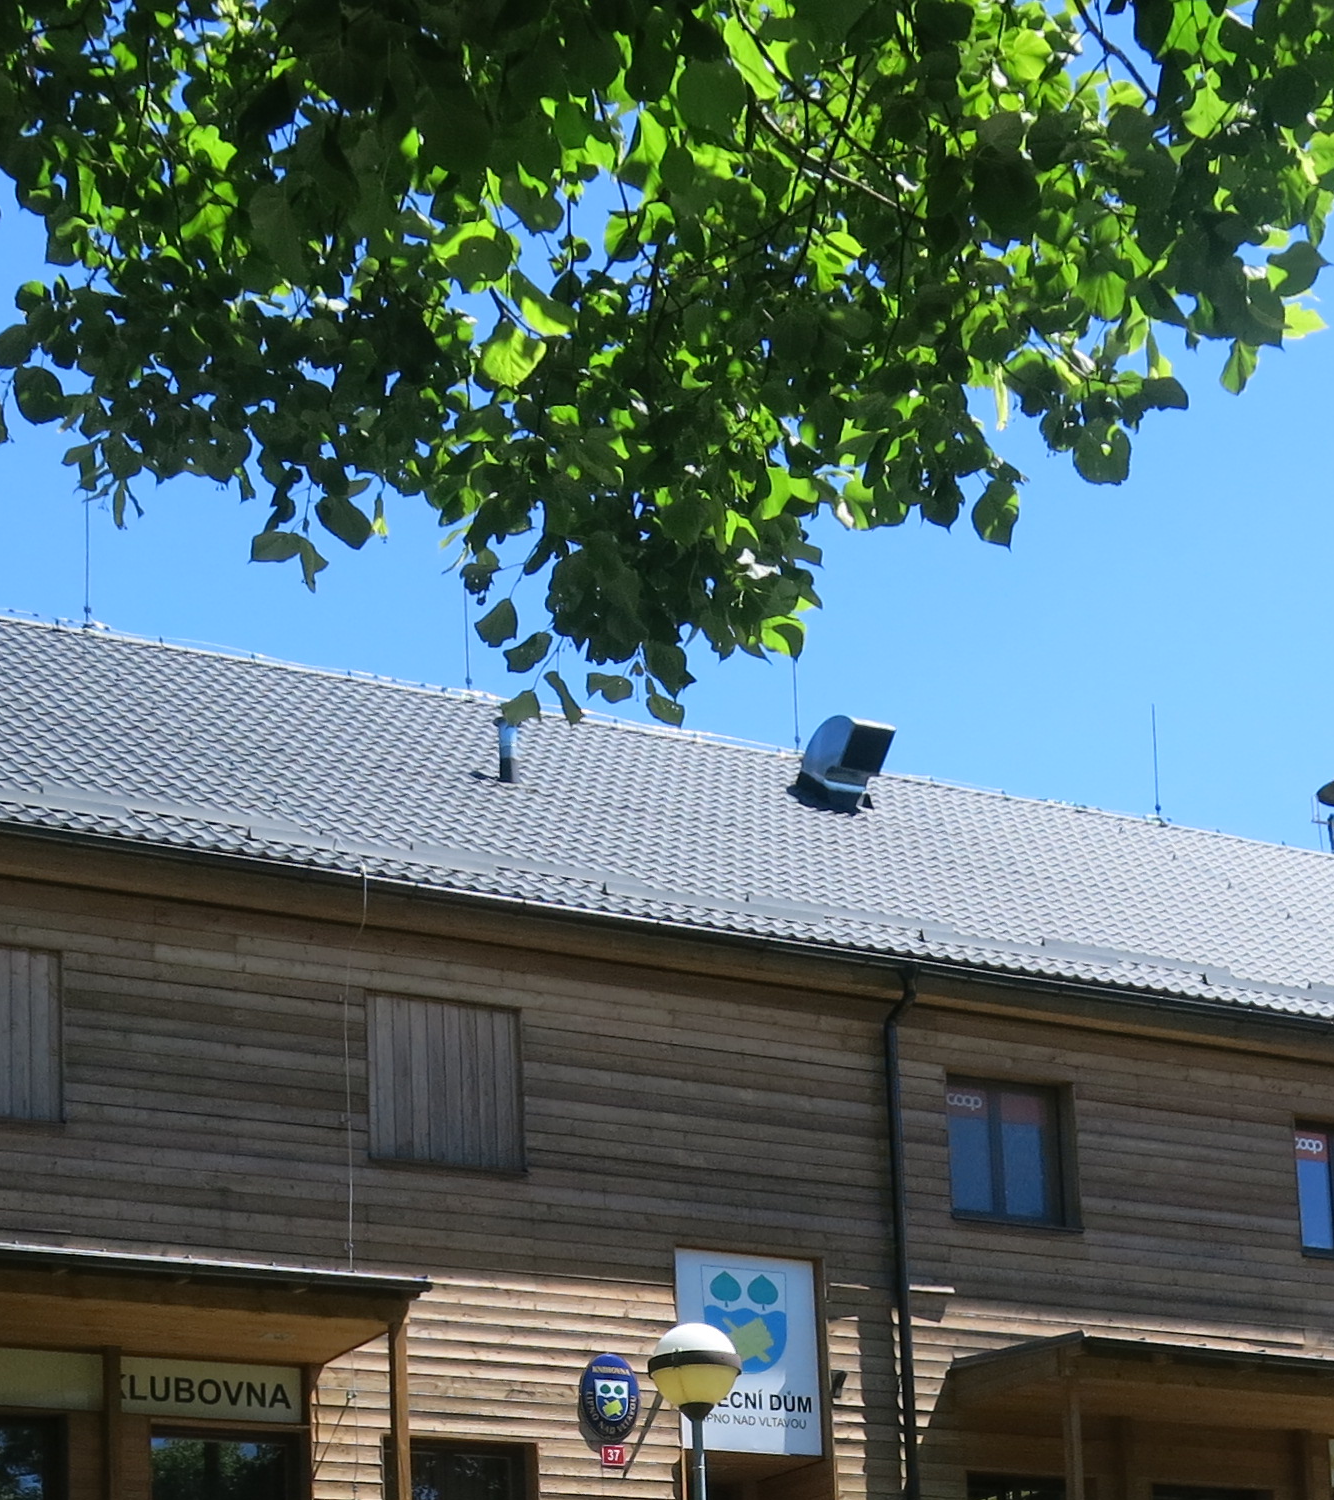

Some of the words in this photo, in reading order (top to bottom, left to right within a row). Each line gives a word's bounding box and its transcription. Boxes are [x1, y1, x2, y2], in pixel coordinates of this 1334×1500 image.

[947, 1093, 982, 1111] coop
[769, 1391, 812, 1413] DŮM
[733, 1414, 756, 1426] NAD
[758, 1416, 807, 1430] VLTAVOU
[607, 1449, 621, 1461] 37
